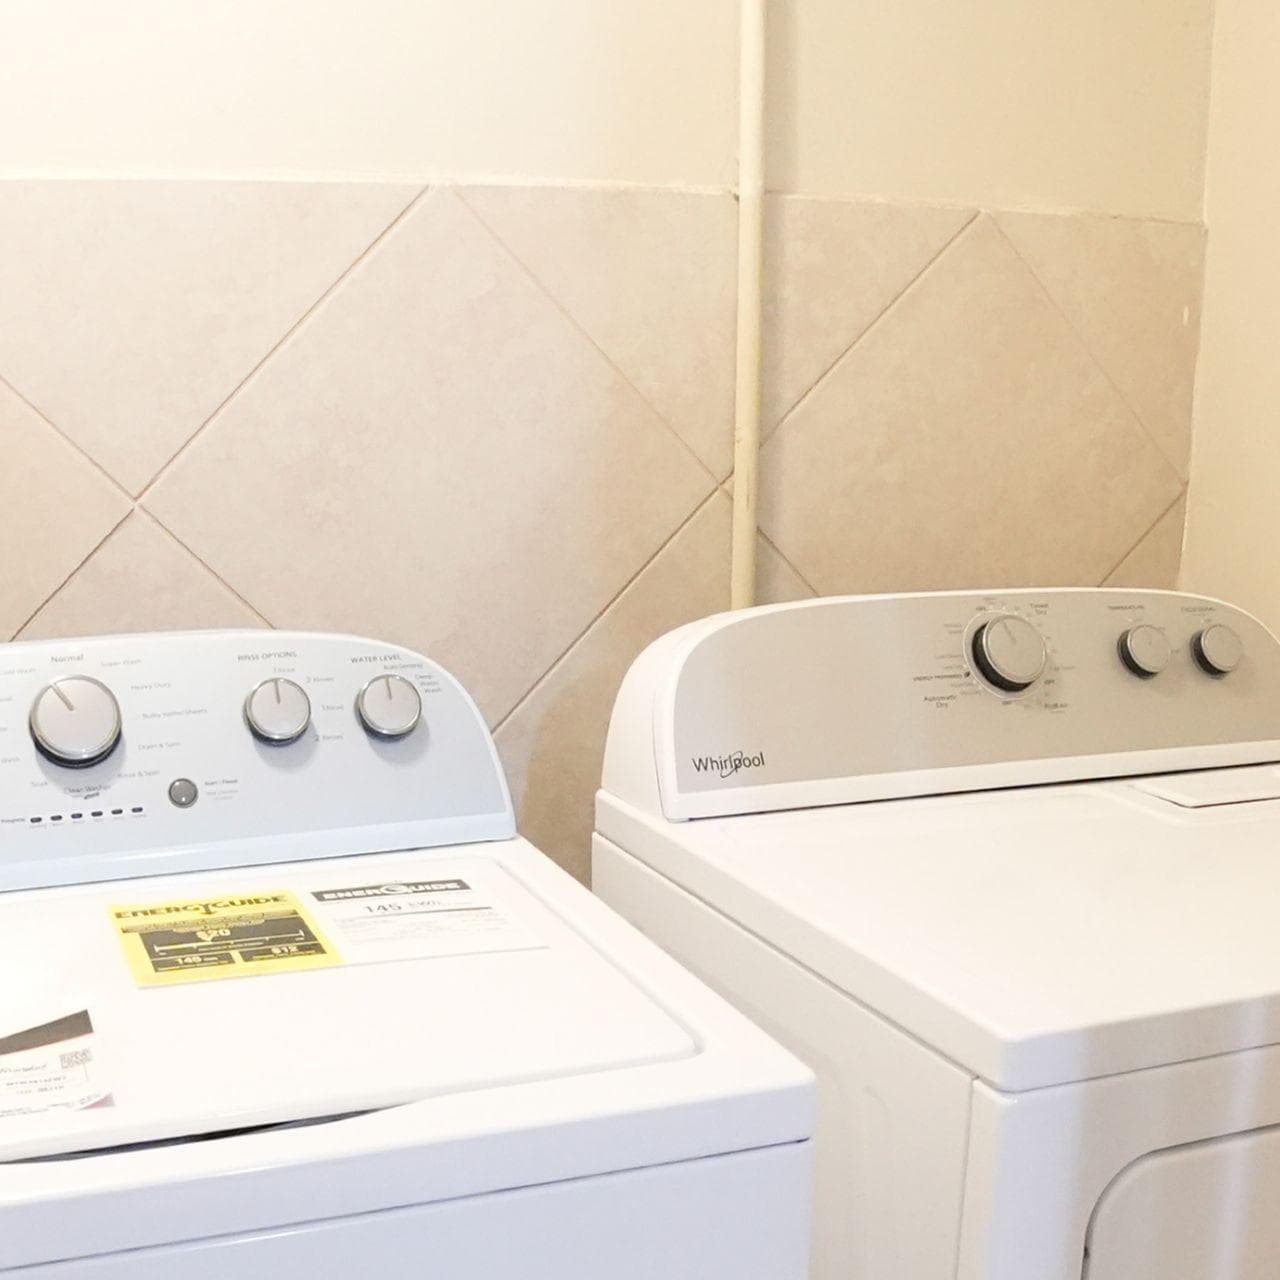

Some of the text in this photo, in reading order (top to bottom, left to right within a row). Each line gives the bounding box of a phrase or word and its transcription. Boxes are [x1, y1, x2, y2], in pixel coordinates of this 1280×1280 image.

[51, 654, 84, 664] Normal
[261, 651, 298, 660] OPTIONS
[350, 654, 402, 664] WATER LEVEL
[691, 751, 765, 778] Whirlpool
[114, 894, 290, 919] ENERGYGUIDE
